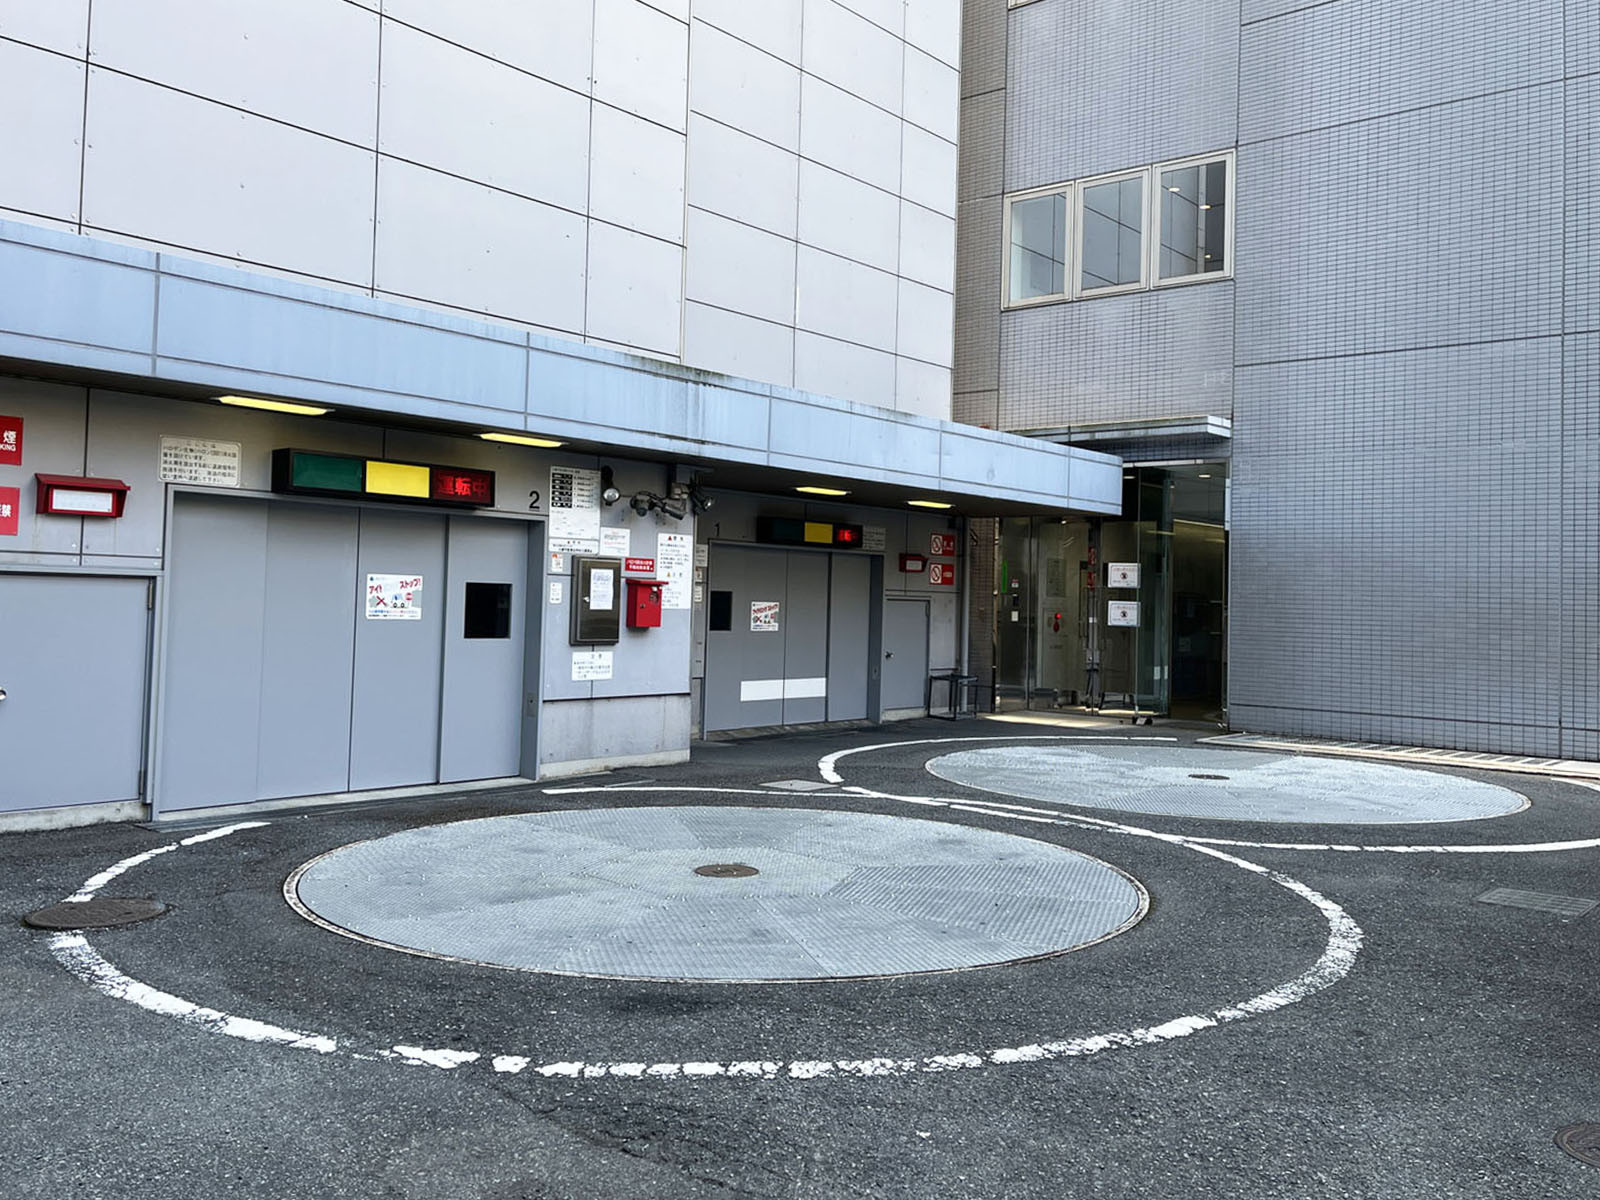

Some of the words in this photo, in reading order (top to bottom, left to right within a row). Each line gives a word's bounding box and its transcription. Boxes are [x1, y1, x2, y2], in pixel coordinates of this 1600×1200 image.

[3, 430, 17, 444] 煙
[439, 476, 488, 497] 運転中
[528, 490, 541, 509] 2
[0, 503, 12, 518] 禁
[714, 522, 720, 536] 1
